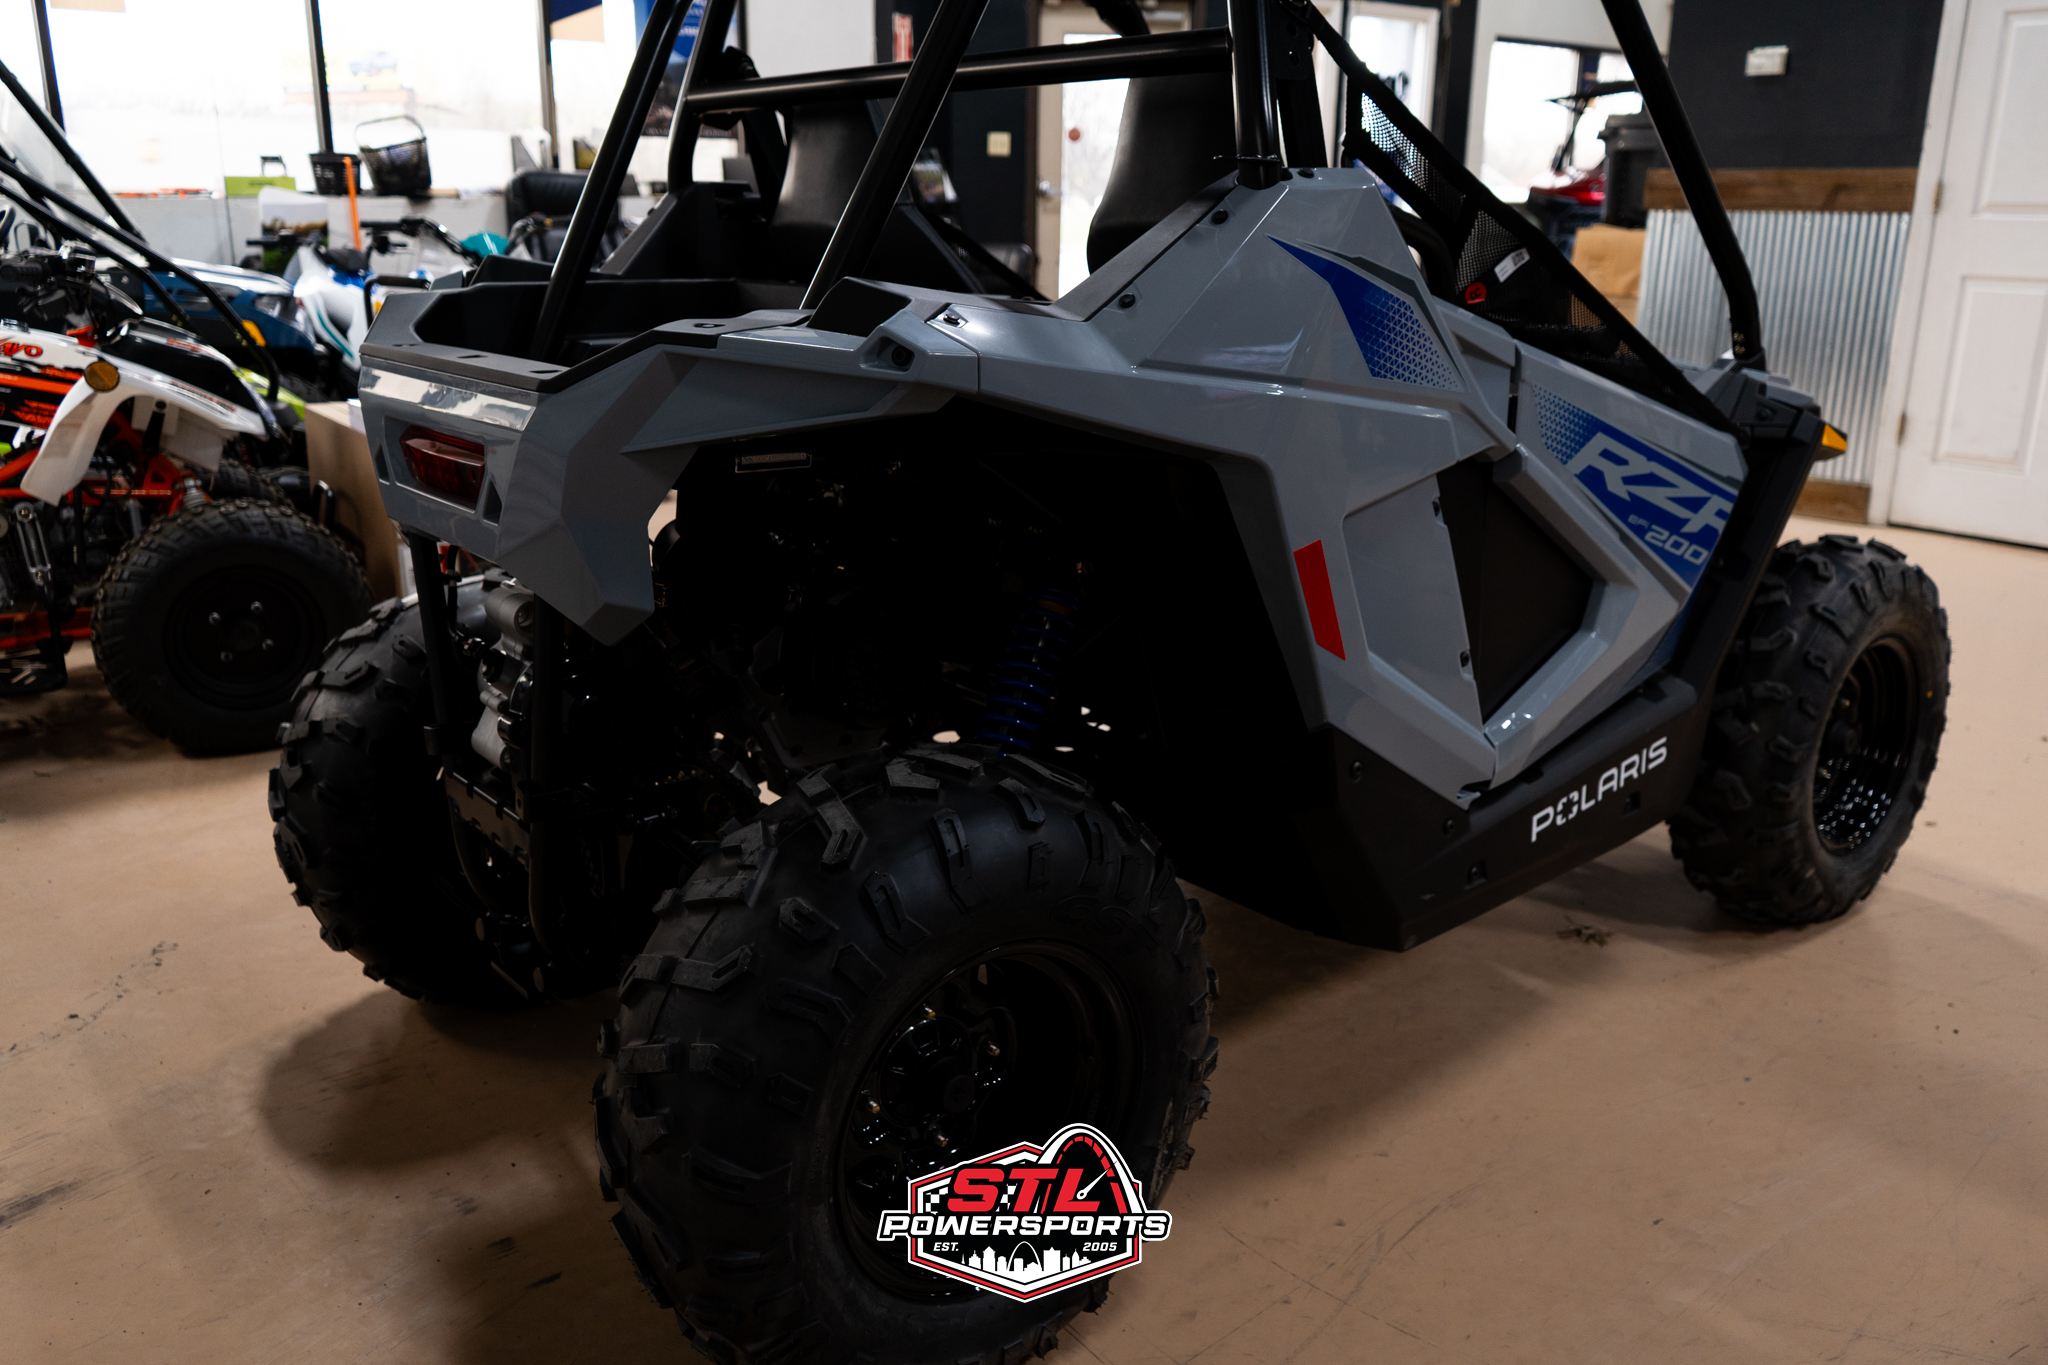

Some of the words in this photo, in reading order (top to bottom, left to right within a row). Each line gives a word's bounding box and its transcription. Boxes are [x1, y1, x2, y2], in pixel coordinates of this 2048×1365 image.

[1627, 513, 1650, 530] EFI
[1644, 524, 1709, 566] 200
[1530, 736, 1668, 843] POLARIS
[1050, 894, 1161, 957] CST
